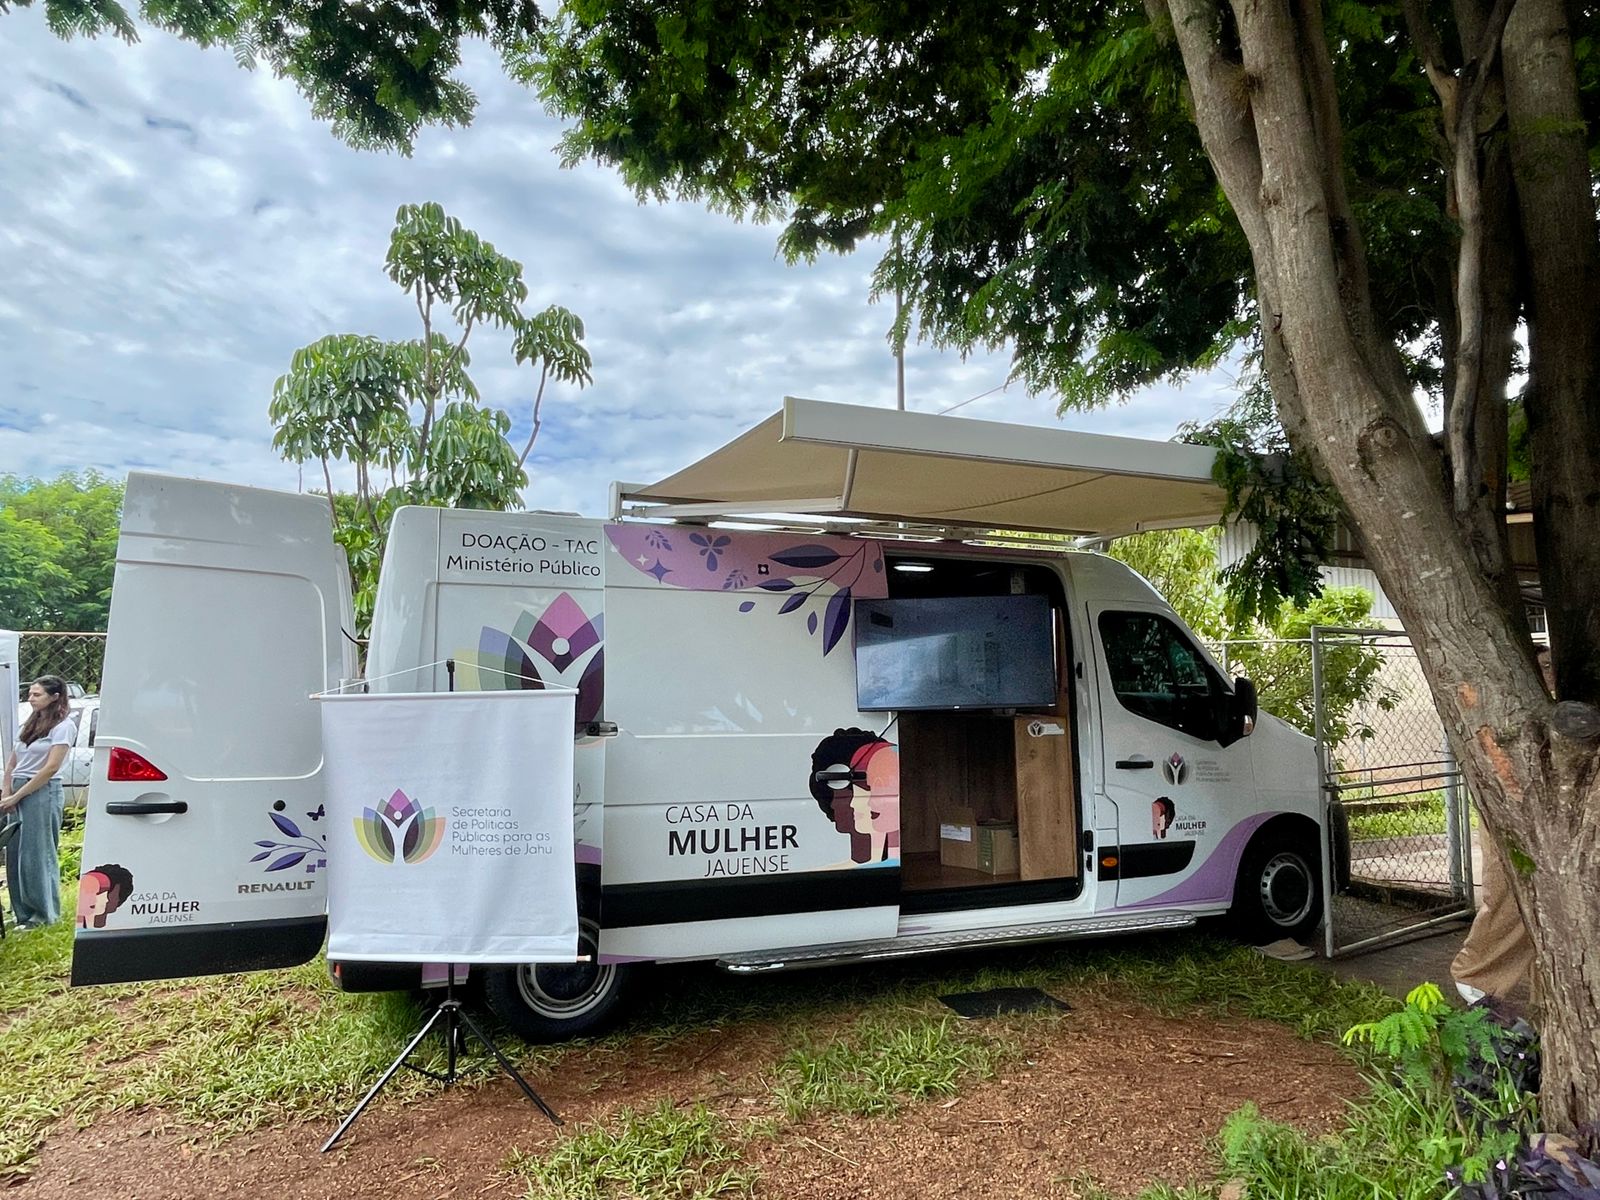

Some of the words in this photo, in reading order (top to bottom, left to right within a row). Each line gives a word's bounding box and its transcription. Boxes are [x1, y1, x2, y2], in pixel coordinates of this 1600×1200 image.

[462, 533, 546, 554] DOAÇÃO
[564, 539, 598, 554] TAC
[446, 555, 534, 573] Ministério
[539, 559, 601, 577] Público
[452, 806, 511, 817] Secretaria
[665, 804, 719, 824] CASA
[726, 803, 754, 821] DA
[452, 819, 468, 830] de
[1175, 821, 1207, 831] MULHER
[503, 832, 532, 844] para
[535, 832, 551, 841] as
[668, 824, 800, 856] MULHER
[451, 844, 502, 856] Mulheres
[505, 845, 521, 855] de
[524, 843, 553, 855] Jahu
[704, 854, 790, 877] JAUENSE
[237, 880, 315, 894] RENAULT
[130, 892, 159, 902] CASA
[162, 891, 178, 901] DA
[131, 901, 200, 915] MULHER
[148, 913, 195, 924] JAUENSE
